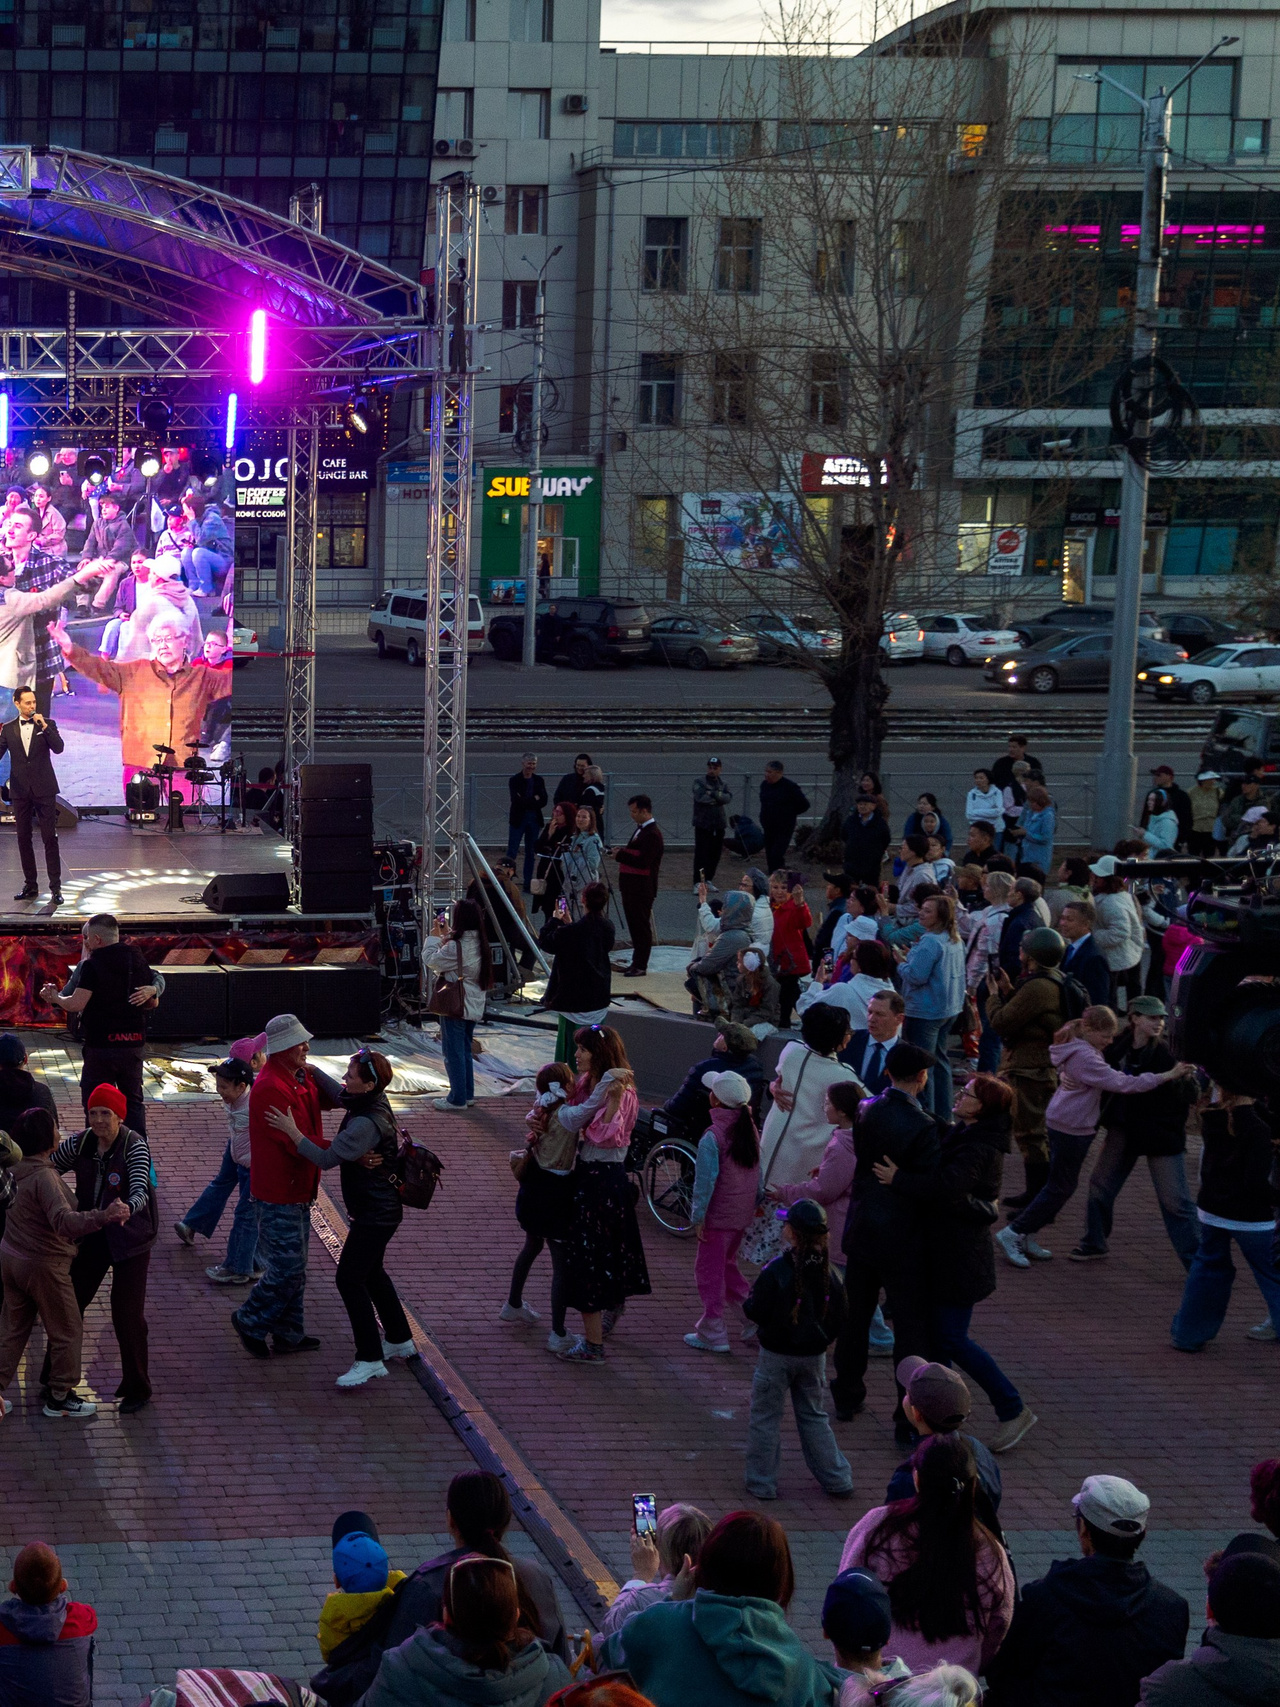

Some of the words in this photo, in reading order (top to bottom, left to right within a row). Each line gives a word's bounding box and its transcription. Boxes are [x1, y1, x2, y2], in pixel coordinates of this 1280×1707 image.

[322, 458, 347, 468] CAFE
[349, 470, 368, 480] BAR
[247, 487, 286, 497] COFFEE
[486, 476, 593, 498] SUBWAY
[235, 510, 255, 518] КОФЕ
[262, 509, 286, 518] СОБОЙ
[107, 1032, 143, 1042] CANADA
